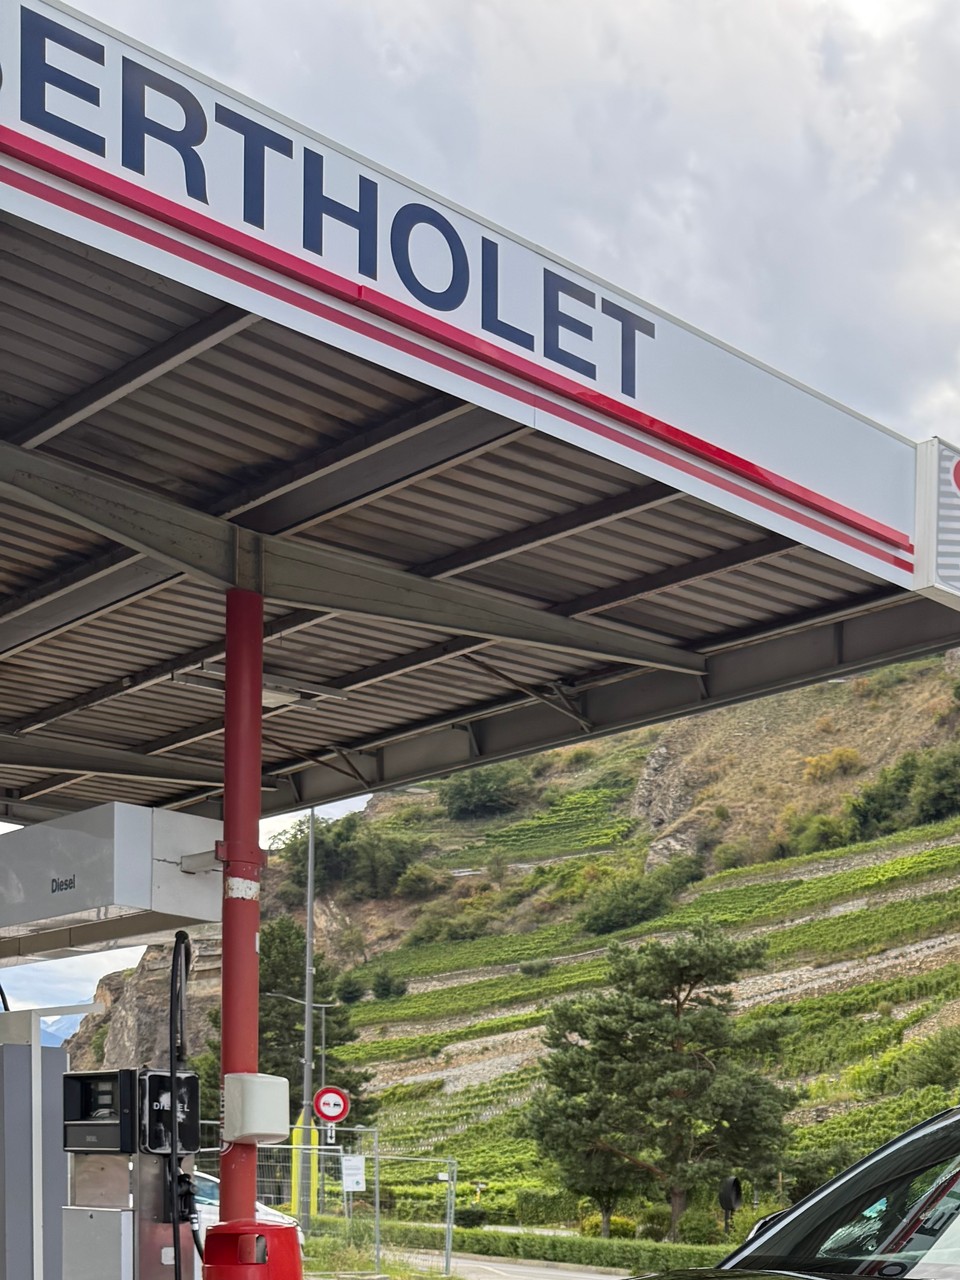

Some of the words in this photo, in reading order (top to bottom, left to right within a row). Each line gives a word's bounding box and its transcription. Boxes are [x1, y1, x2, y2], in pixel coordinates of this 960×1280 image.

[0, 5, 656, 399] ERTHOLET
[51, 874, 76, 893] Diesel
[153, 1102, 190, 1112] DIEEL
